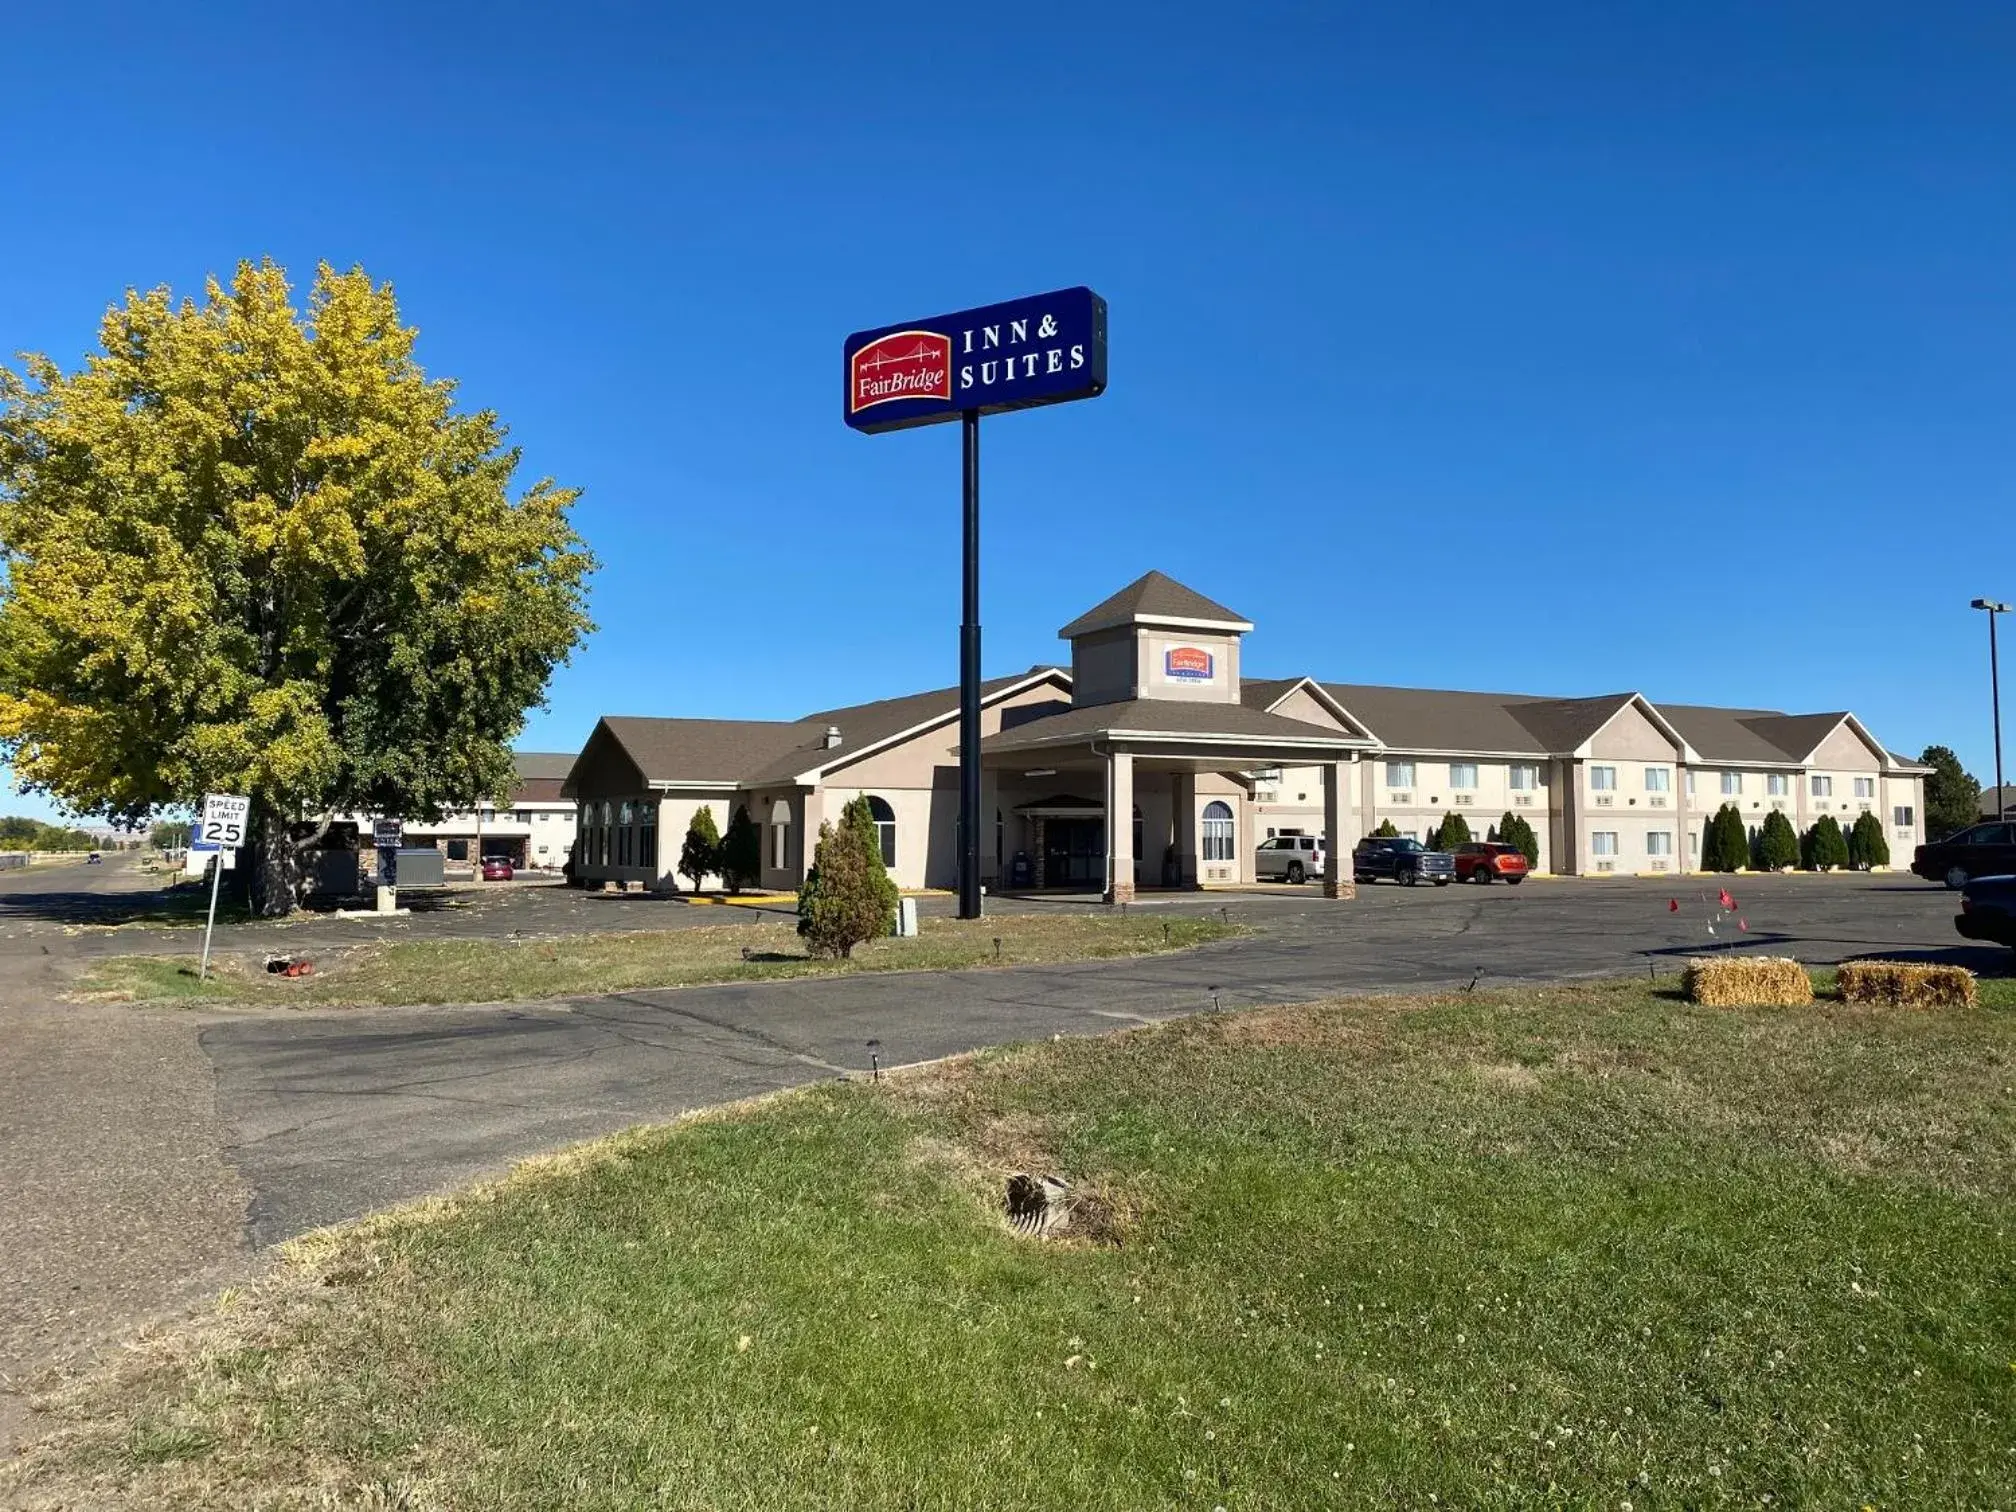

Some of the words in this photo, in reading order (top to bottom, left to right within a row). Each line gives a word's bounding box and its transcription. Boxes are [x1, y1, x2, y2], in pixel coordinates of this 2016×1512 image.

[963, 319, 1028, 353] INN
[1038, 313, 1058, 339] &
[961, 344, 1084, 389] SUITES
[859, 368, 944, 399] FairBridge
[209, 800, 246, 811] SPEED
[211, 811, 240, 820] LIMIT
[205, 822, 240, 842] 25
